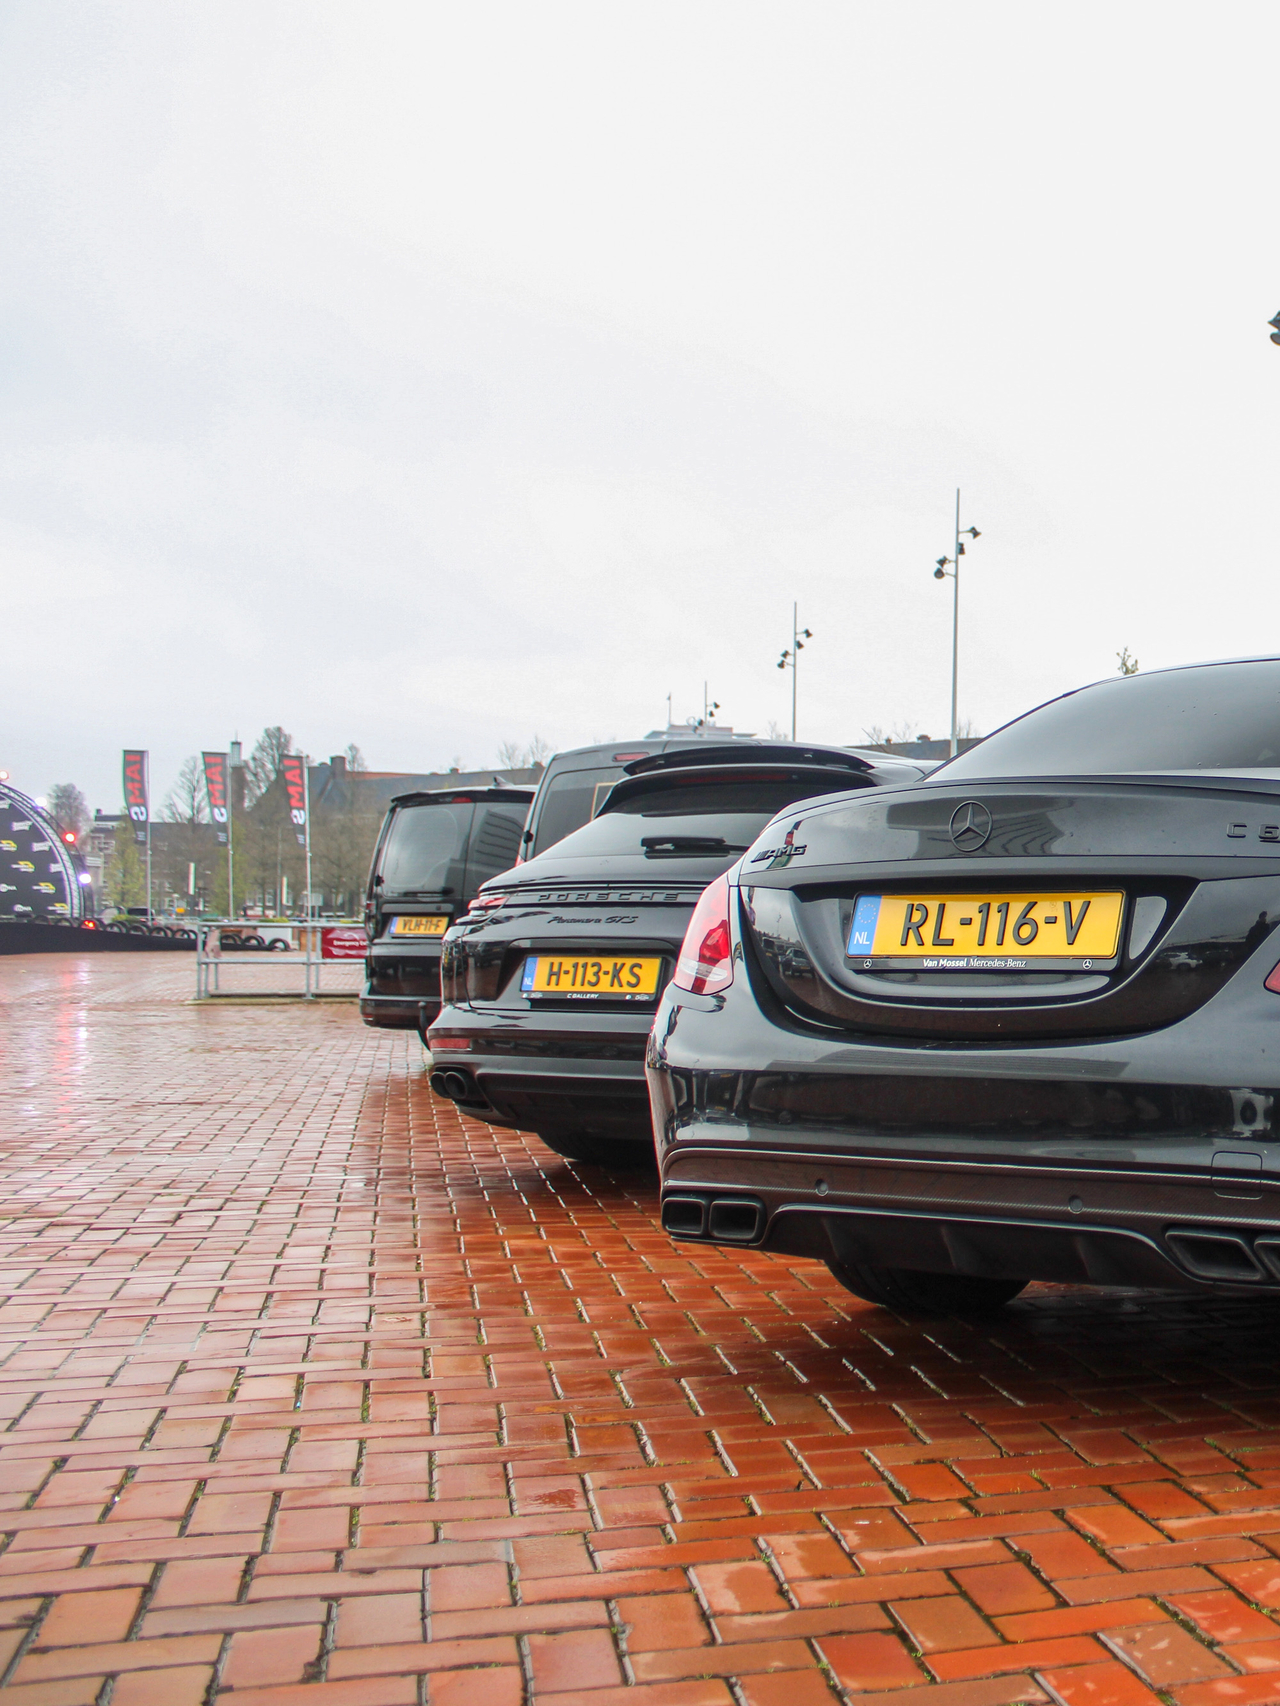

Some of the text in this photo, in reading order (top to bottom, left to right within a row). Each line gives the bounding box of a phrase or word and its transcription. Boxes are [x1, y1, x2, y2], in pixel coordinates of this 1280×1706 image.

[1226, 822, 1248, 839] C
[538, 891, 680, 902] PORSCHE
[547, 915, 639, 924] Panamera GTS
[900, 900, 1092, 947] RL-116-V
[853, 931, 871, 946] NL
[923, 958, 1027, 969] Van Mossel Mercedes-Benz
[523, 977, 533, 986] NL
[546, 961, 643, 989] H-113-KS
